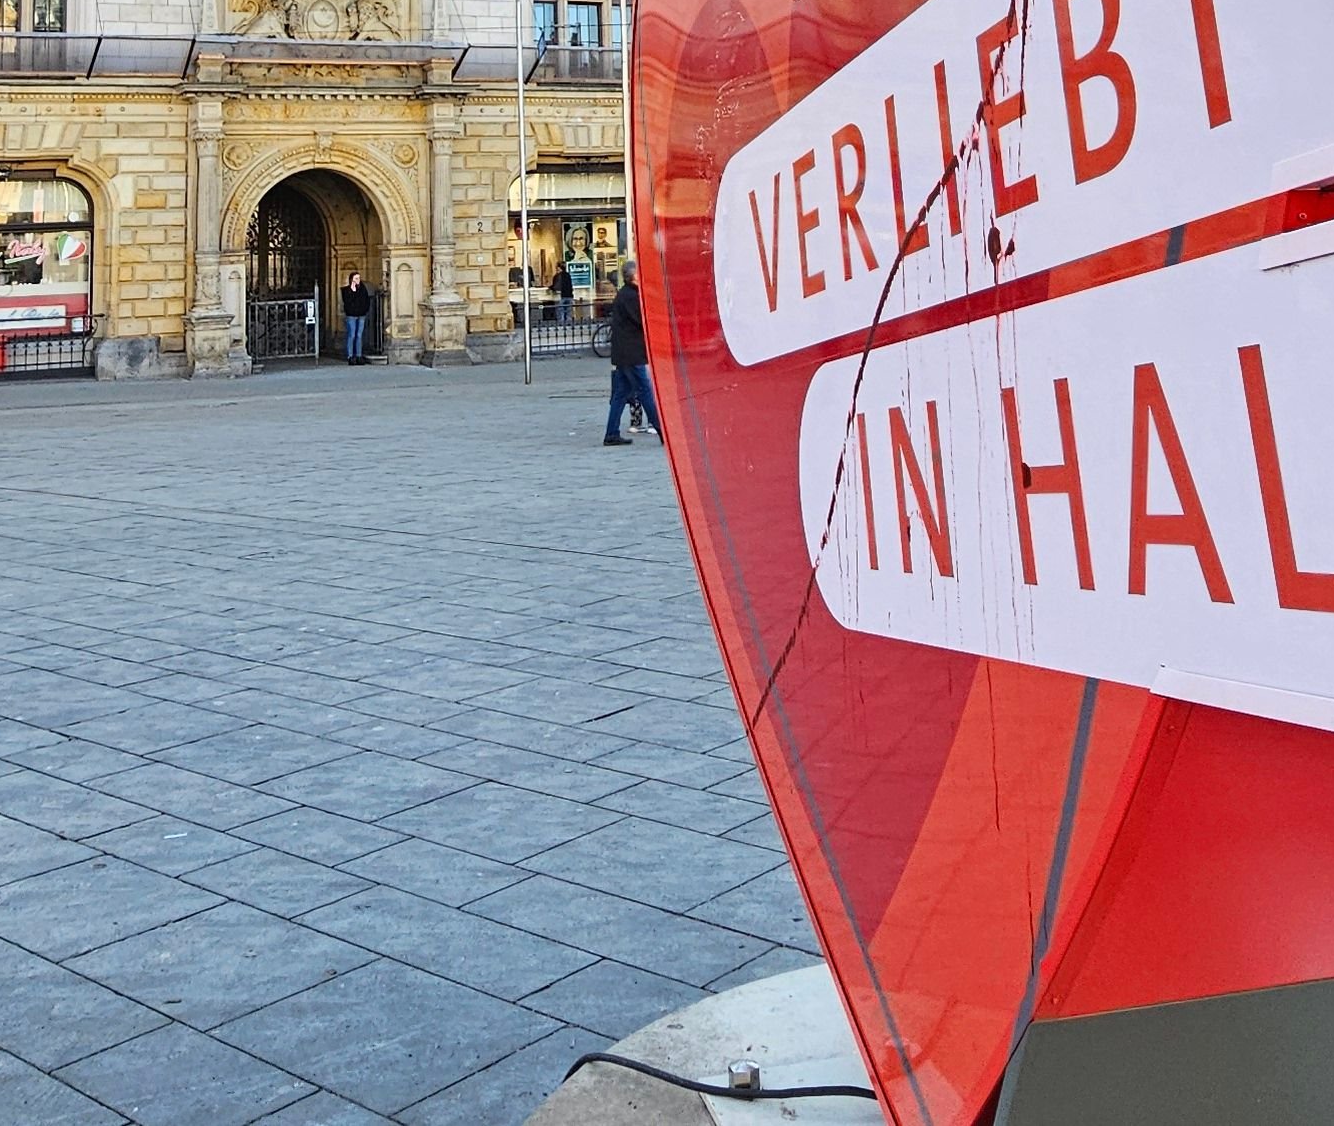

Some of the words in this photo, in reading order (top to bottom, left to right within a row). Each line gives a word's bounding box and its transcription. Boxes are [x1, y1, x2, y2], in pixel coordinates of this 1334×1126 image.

[477, 221, 484, 233] 2
[7, 239, 50, 266] Italy
[857, 399, 954, 578] IN
